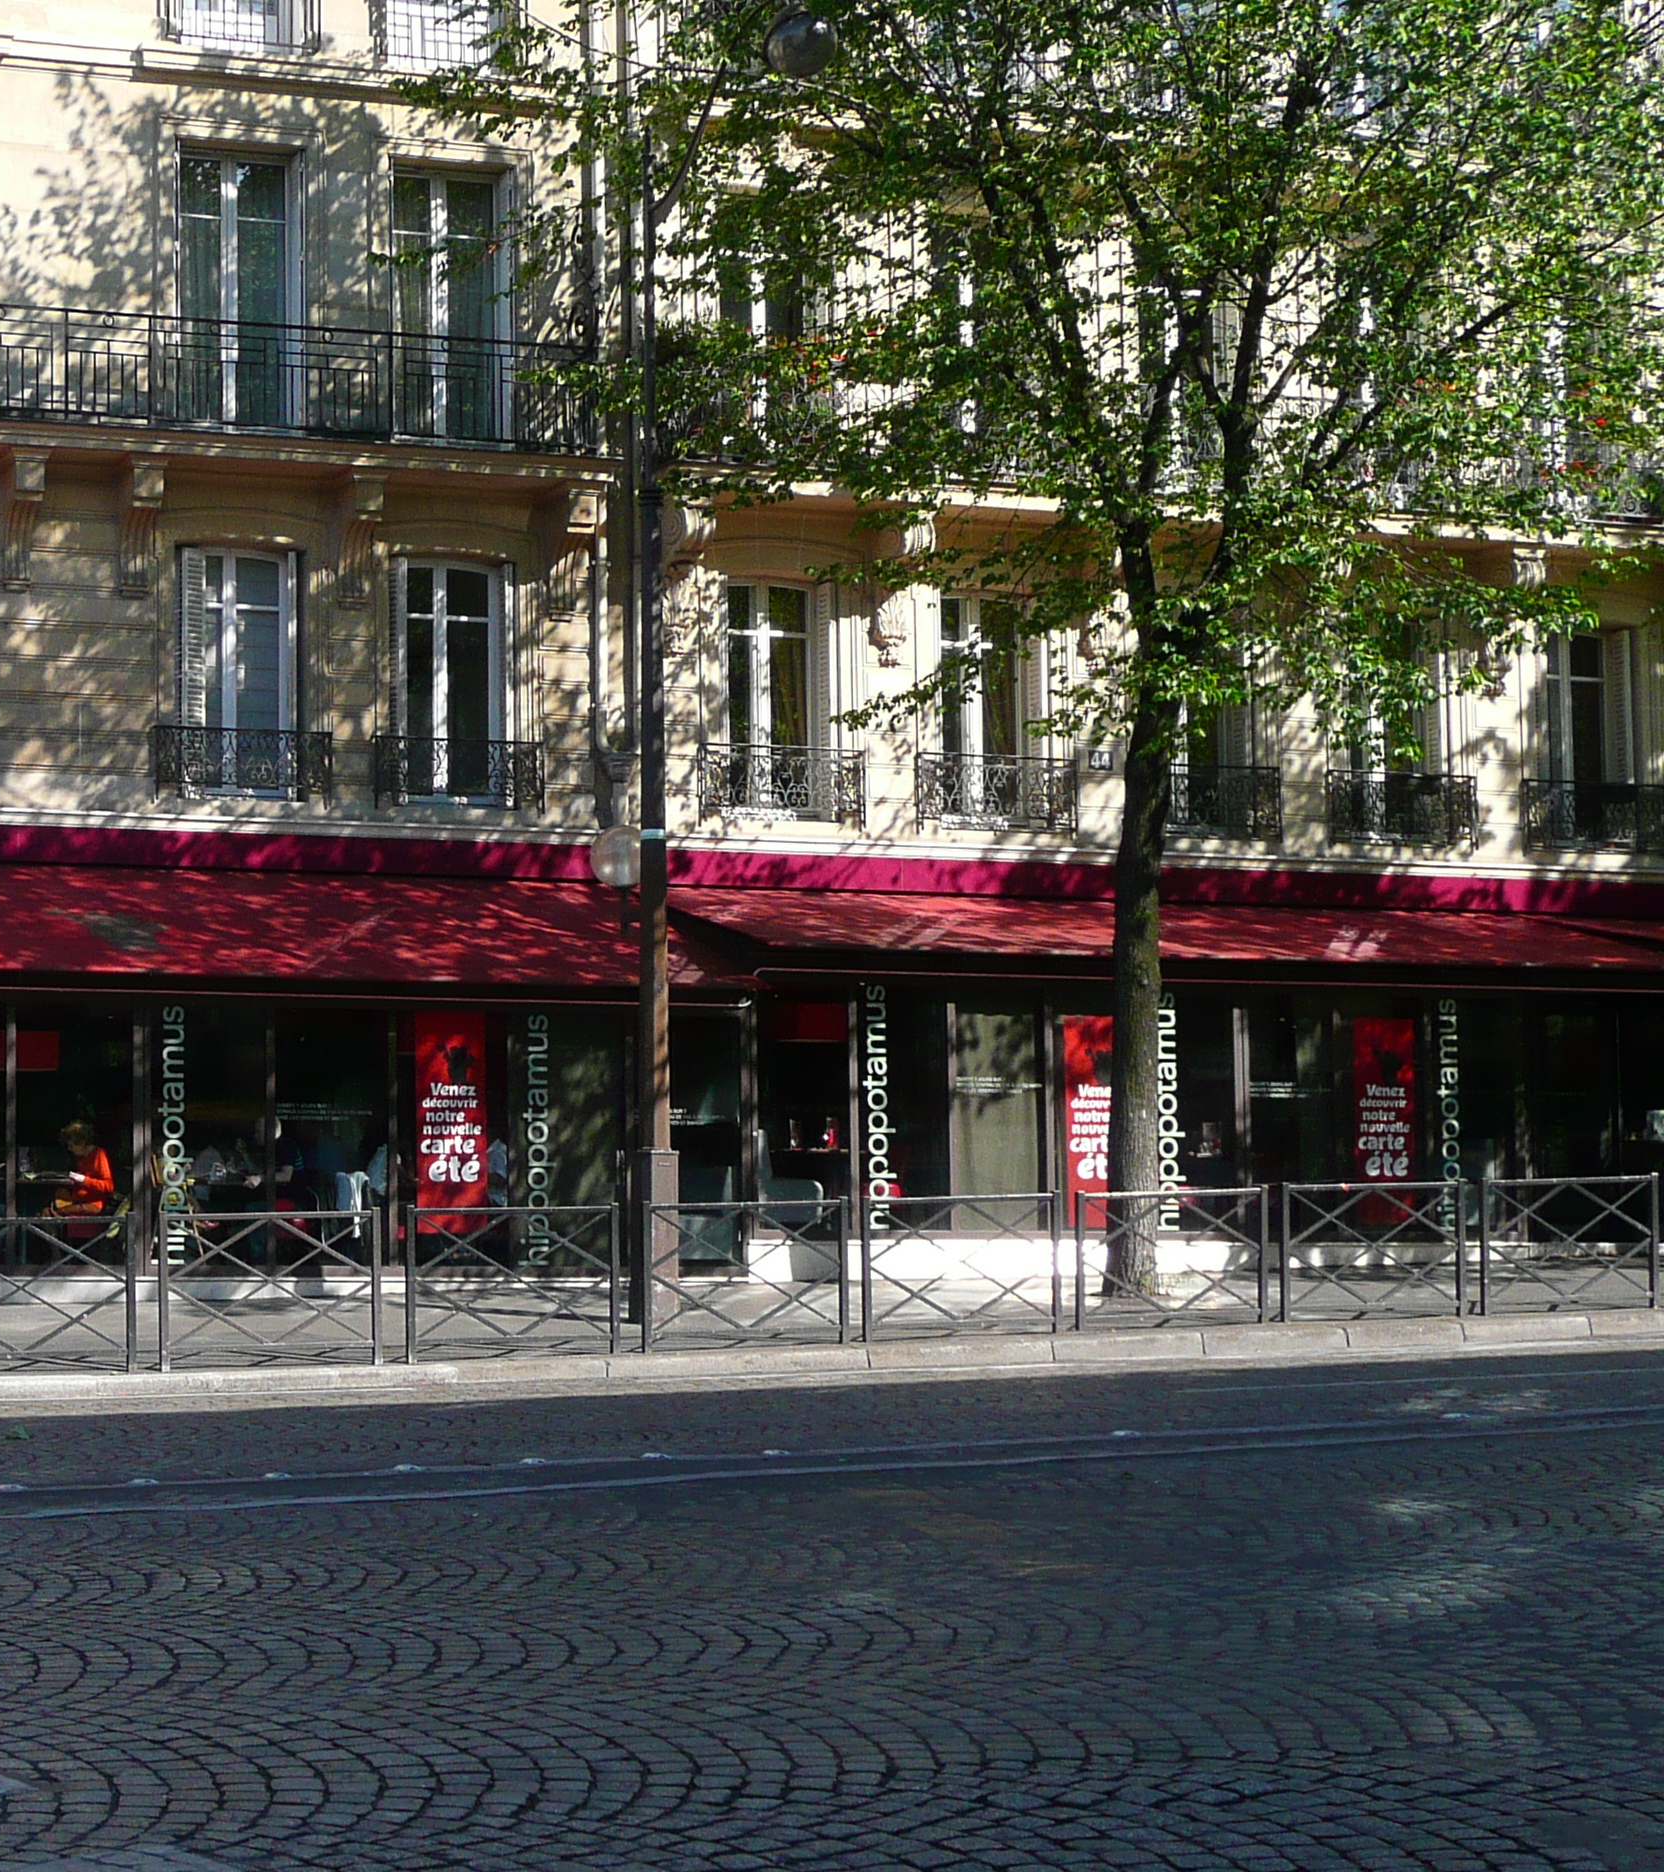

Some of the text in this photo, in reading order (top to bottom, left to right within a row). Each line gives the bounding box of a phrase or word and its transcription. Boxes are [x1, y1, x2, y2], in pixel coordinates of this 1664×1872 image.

[1091, 752, 1111, 769] 44
[430, 1082, 476, 1096] Venez
[1078, 1084, 1112, 1098] Vene
[1366, 1084, 1405, 1097] Venez
[422, 1097, 478, 1108] découvrir
[1359, 1097, 1408, 1108] découvrir
[425, 1110, 465, 1122] notre
[1362, 1110, 1396, 1121] notre
[1437, 998, 1460, 1232] hipopotamus
[422, 1122, 483, 1135] nouvelle
[1360, 1121, 1410, 1133] nouvelle
[420, 1136, 476, 1154] carte
[518, 1013, 557, 1266] hippopotamus
[1070, 1135, 1108, 1153] cart
[1358, 1134, 1405, 1150] carte
[428, 1154, 481, 1182] été
[1077, 1152, 1108, 1180] ét
[1365, 1151, 1409, 1177] été
